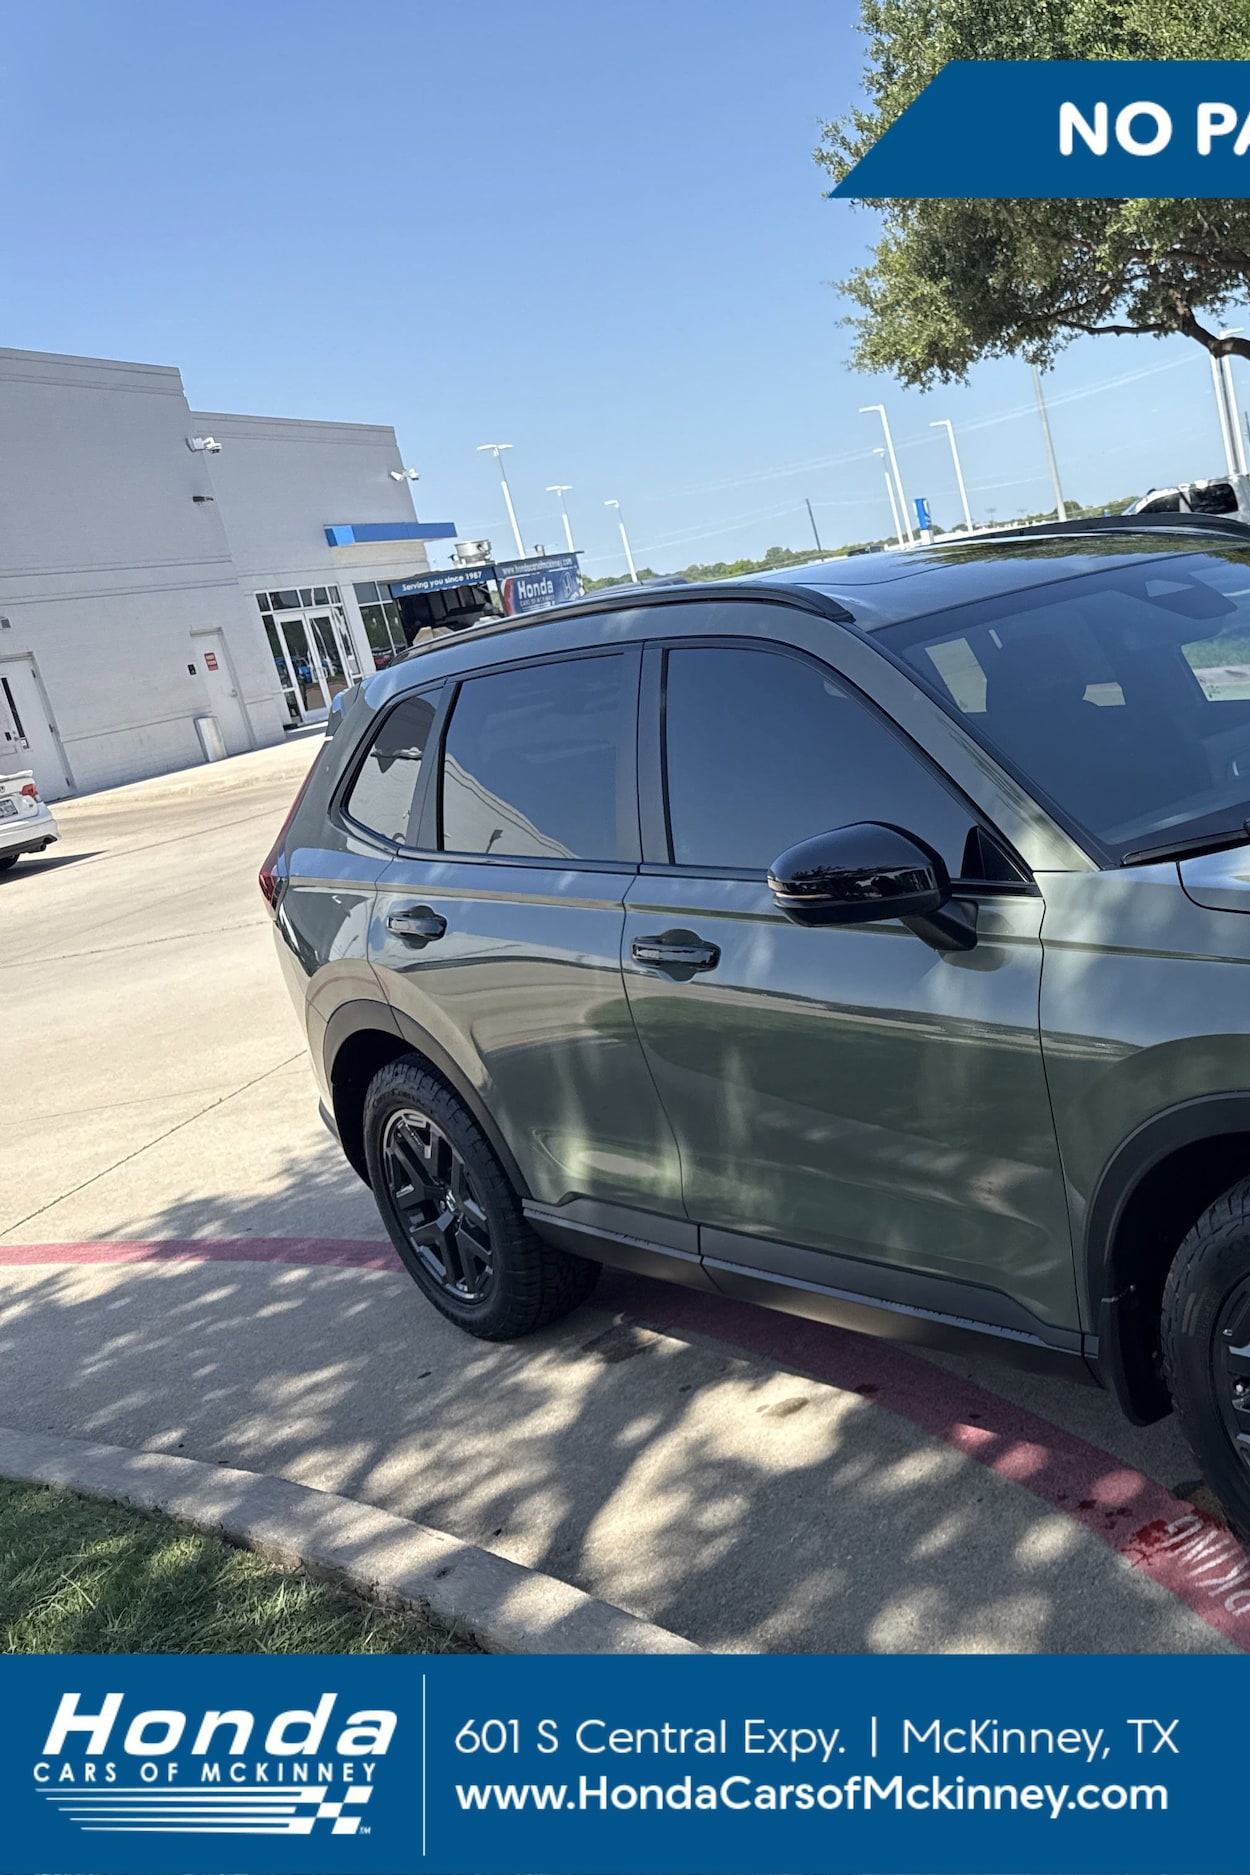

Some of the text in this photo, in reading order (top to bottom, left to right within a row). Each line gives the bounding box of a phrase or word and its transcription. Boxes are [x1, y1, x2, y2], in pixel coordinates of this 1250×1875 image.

[402, 571, 482, 592] Serving you since 1987
[518, 578, 554, 599] Honda
